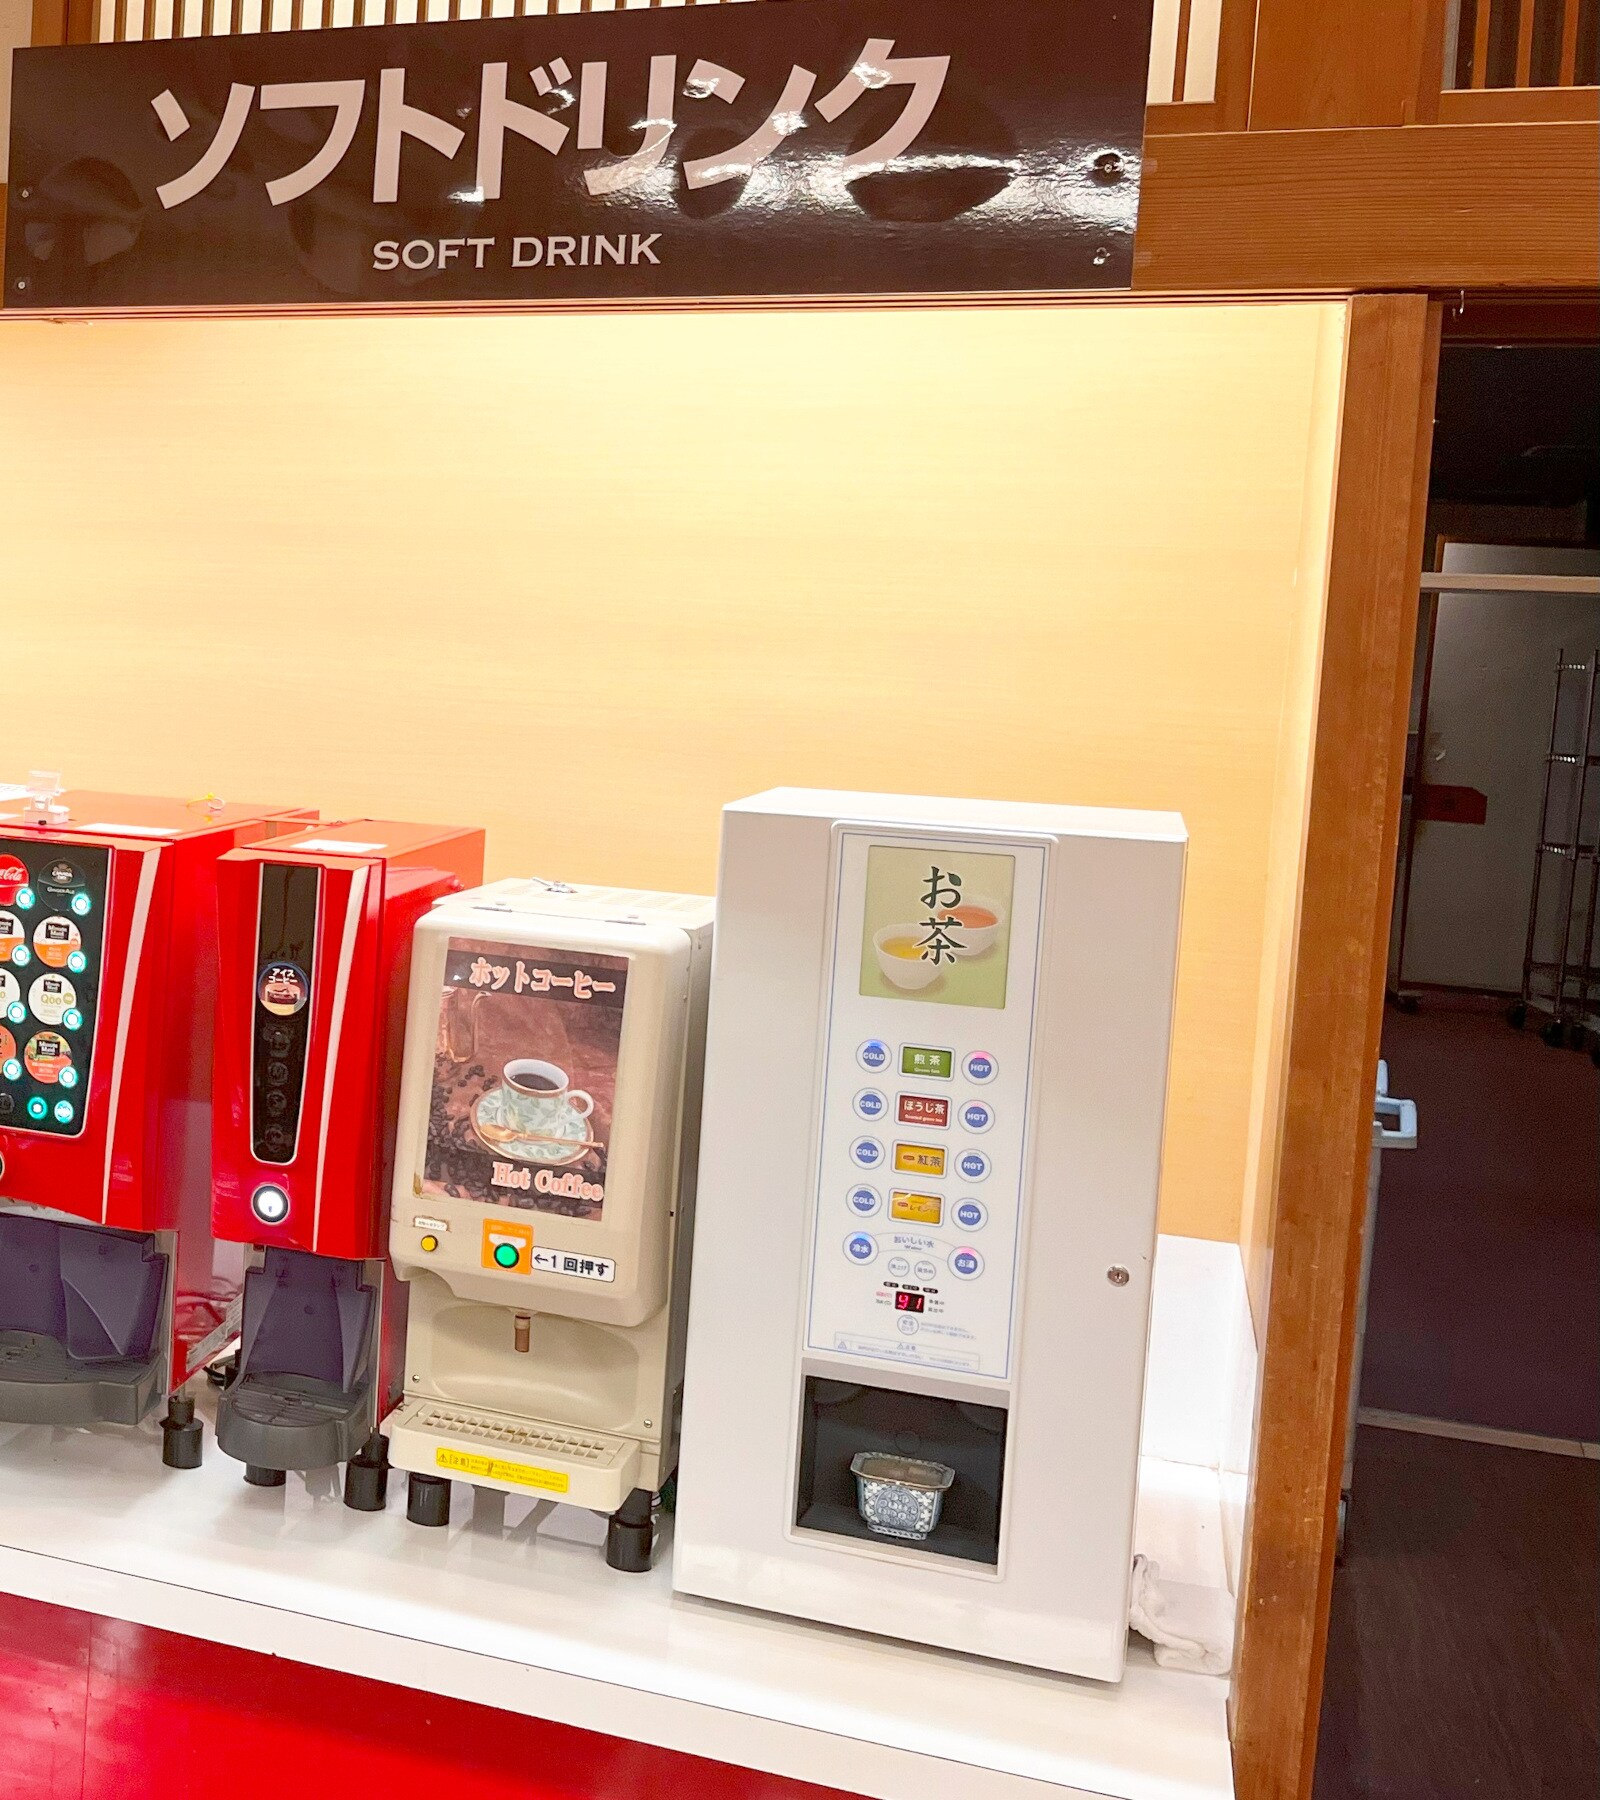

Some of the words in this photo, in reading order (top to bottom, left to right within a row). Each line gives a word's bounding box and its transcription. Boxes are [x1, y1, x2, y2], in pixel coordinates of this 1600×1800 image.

[151, 37, 951, 208] ソフトドリンク
[373, 236, 497, 271] SOFT
[511, 232, 662, 269] DRINK
[915, 866, 968, 966] お茶
[272, 968, 295, 977] アイス
[469, 956, 616, 999] ホットコーヒー
[40, 993, 62, 1005] Qoo
[862, 1051, 885, 1061] COLD
[970, 1064, 990, 1073] HOT
[859, 1100, 882, 1110] COLD
[903, 1100, 945, 1115] ほうじ茶
[966, 1112, 986, 1122] HOT
[856, 1148, 878, 1157] COLD
[917, 1154, 942, 1167] 紅茶
[963, 1161, 983, 1170] HOT
[490, 1161, 531, 1191] Hot
[534, 1168, 605, 1202] Coffee
[853, 1197, 875, 1206] COLD
[960, 1210, 979, 1219] HOT
